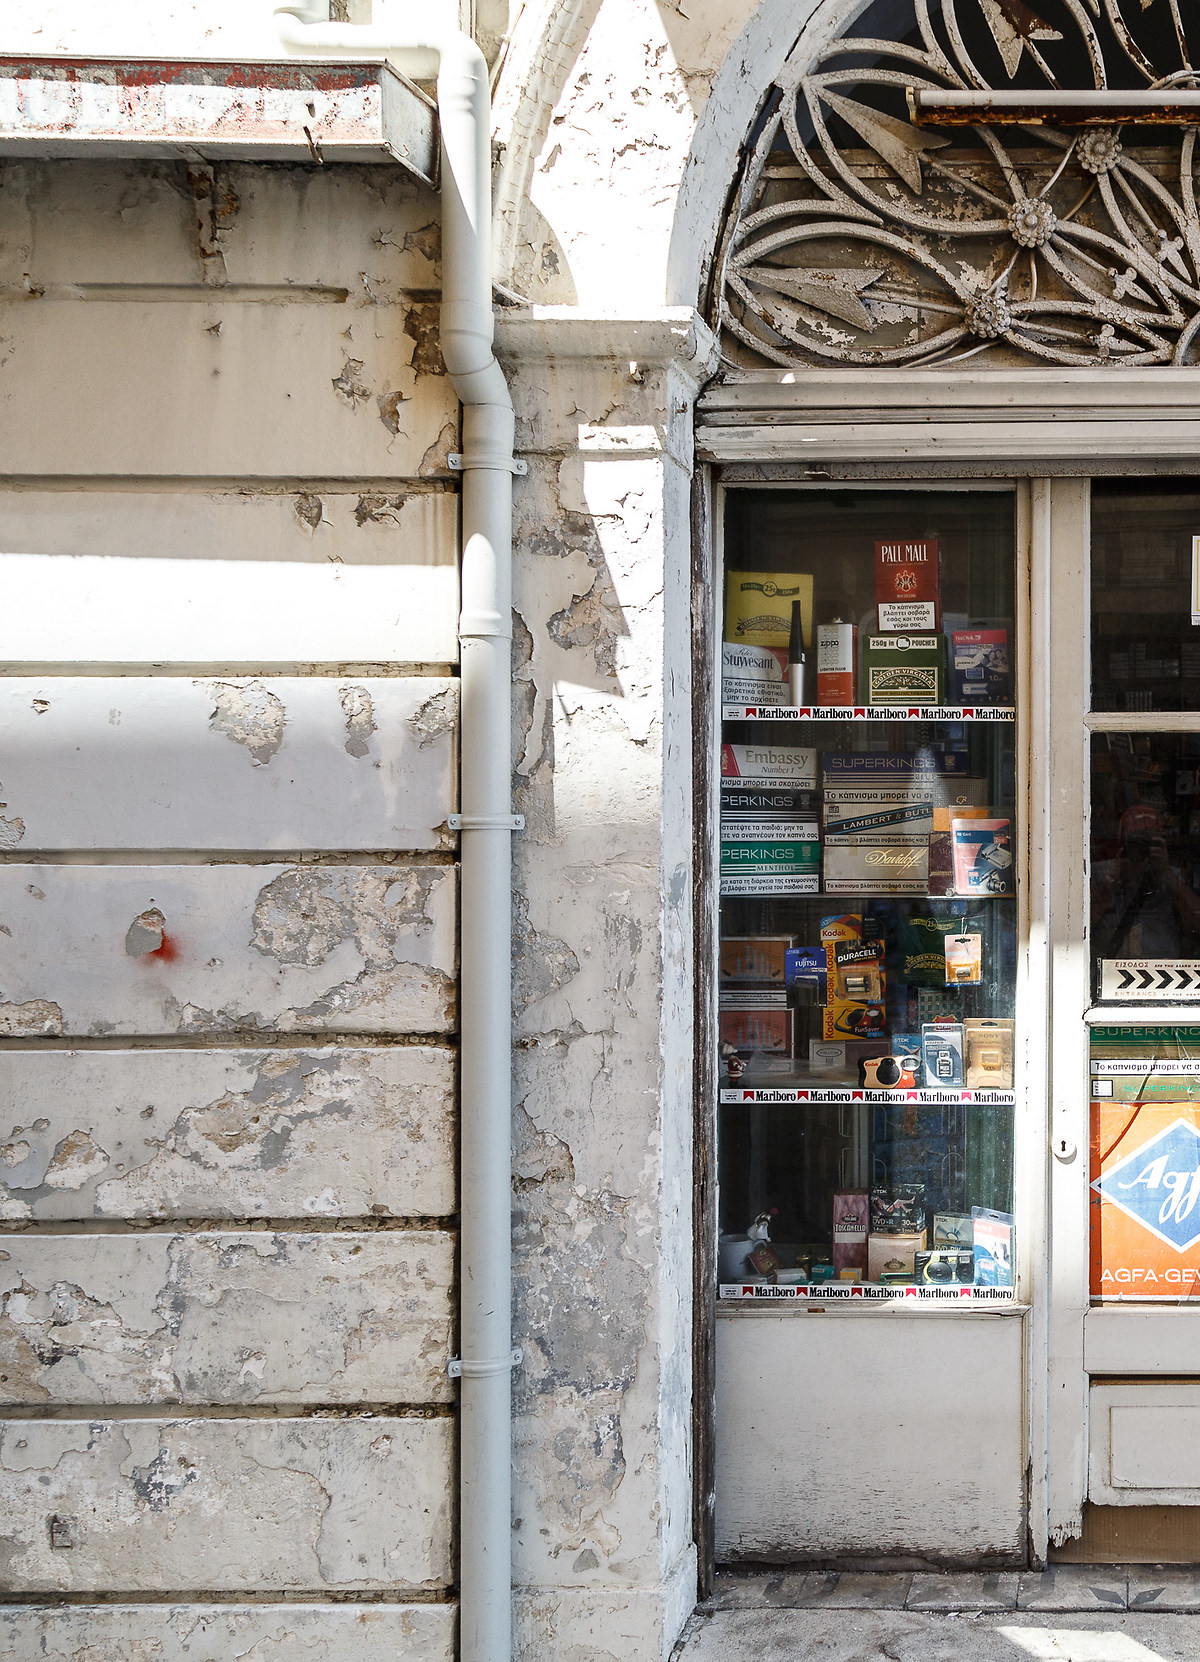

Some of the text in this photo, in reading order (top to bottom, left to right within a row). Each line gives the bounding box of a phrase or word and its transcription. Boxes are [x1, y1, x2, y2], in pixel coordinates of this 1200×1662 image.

[881, 545, 928, 563] PALL MALL
[820, 640, 839, 648] zippo
[723, 651, 774, 670] Stuyvesant
[874, 669, 933, 686] GOLDEN VIRGINIA
[758, 708, 1015, 721] Marlboro Marlboro Marlboro Marlboro Marlboro
[746, 750, 808, 769] Embassy
[832, 758, 936, 768] SUPERKINGS
[761, 766, 789, 774] Number
[825, 791, 836, 799] Το
[839, 790, 878, 800] κάπνισμα
[880, 790, 909, 800] μπορεί
[843, 815, 892, 830] LAMBERT
[865, 848, 927, 875] Davidoff
[822, 929, 847, 937] Kodak
[837, 949, 877, 963] DURACELL
[795, 958, 817, 968] FUJITSU
[827, 976, 835, 1006] Kodak
[826, 1010, 834, 1039] Kodak
[755, 1090, 1014, 1102] Marlboro Marlboro Marlboro Marlboro Marlboro
[755, 1286, 1013, 1299] Marlboro Marlboro Marlboro Marlboro Marlboro
